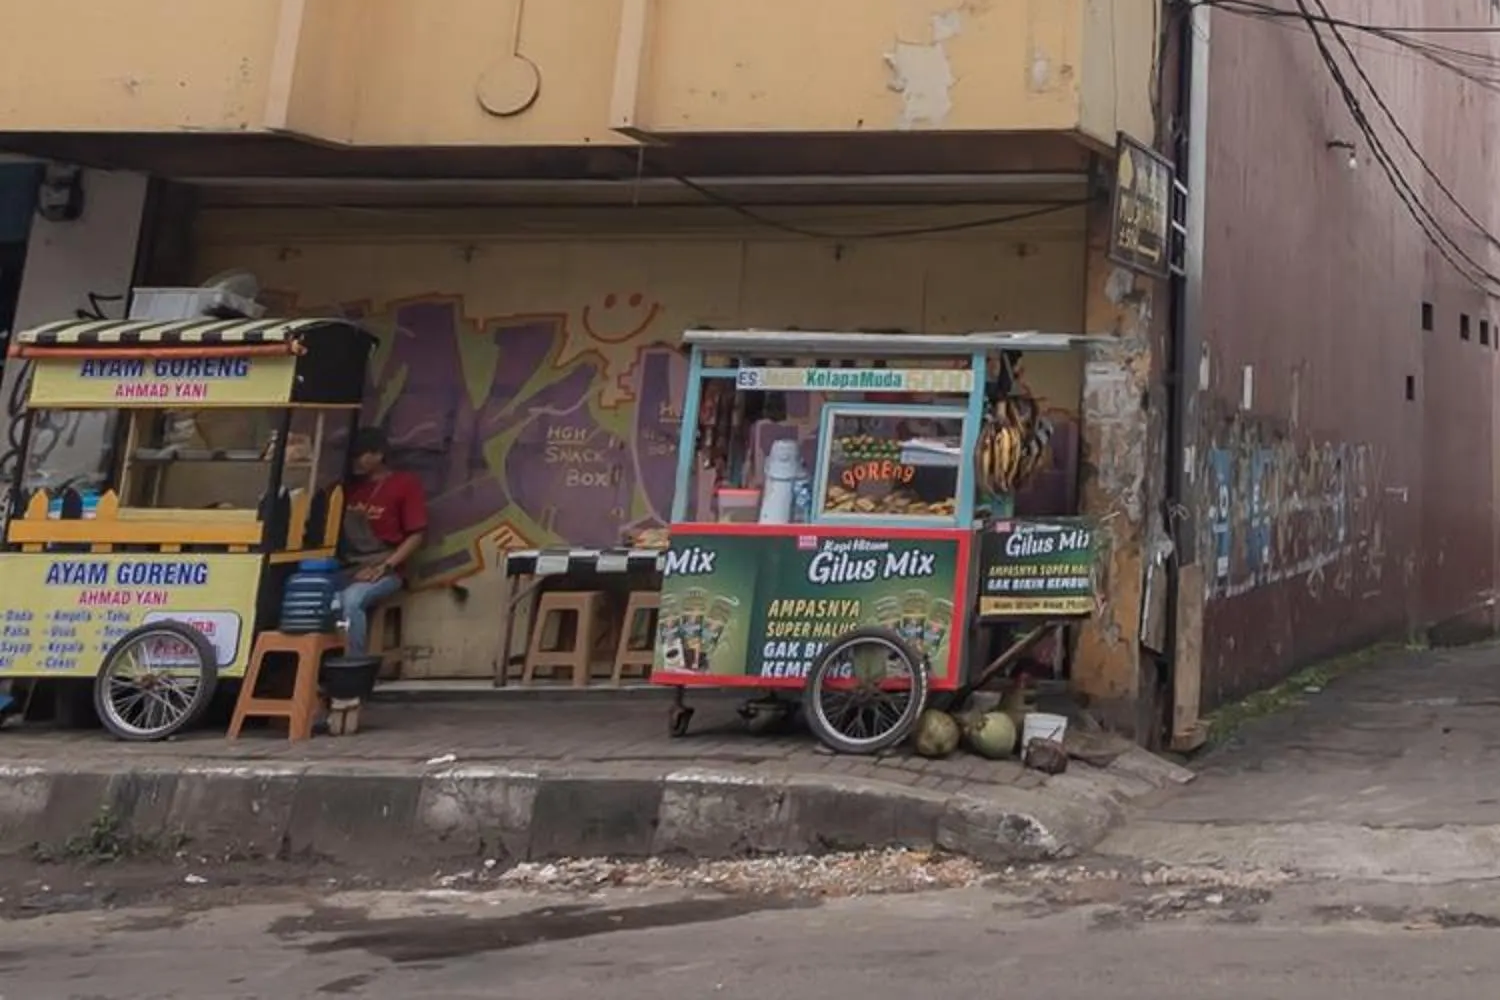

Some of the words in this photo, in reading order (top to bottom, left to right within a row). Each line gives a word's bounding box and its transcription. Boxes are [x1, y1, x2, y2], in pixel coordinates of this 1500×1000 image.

[81, 357, 145, 377] AYAM
[155, 357, 249, 377] GORENG
[115, 383, 169, 398] AHMAD
[175, 383, 208, 398] YANI
[1005, 532, 1054, 558] Gilus
[664, 547, 716, 576] Mix
[808, 552, 877, 584] Gilus
[883, 550, 935, 578] Mix
[46, 563, 109, 585] AYAM
[117, 563, 209, 585] GORENG
[78, 589, 131, 606] AHMAD
[136, 589, 170, 606] YANI
[768, 599, 860, 617] AMPASNYA
[766, 621, 811, 638] SUPER
[763, 641, 799, 659] GAK
